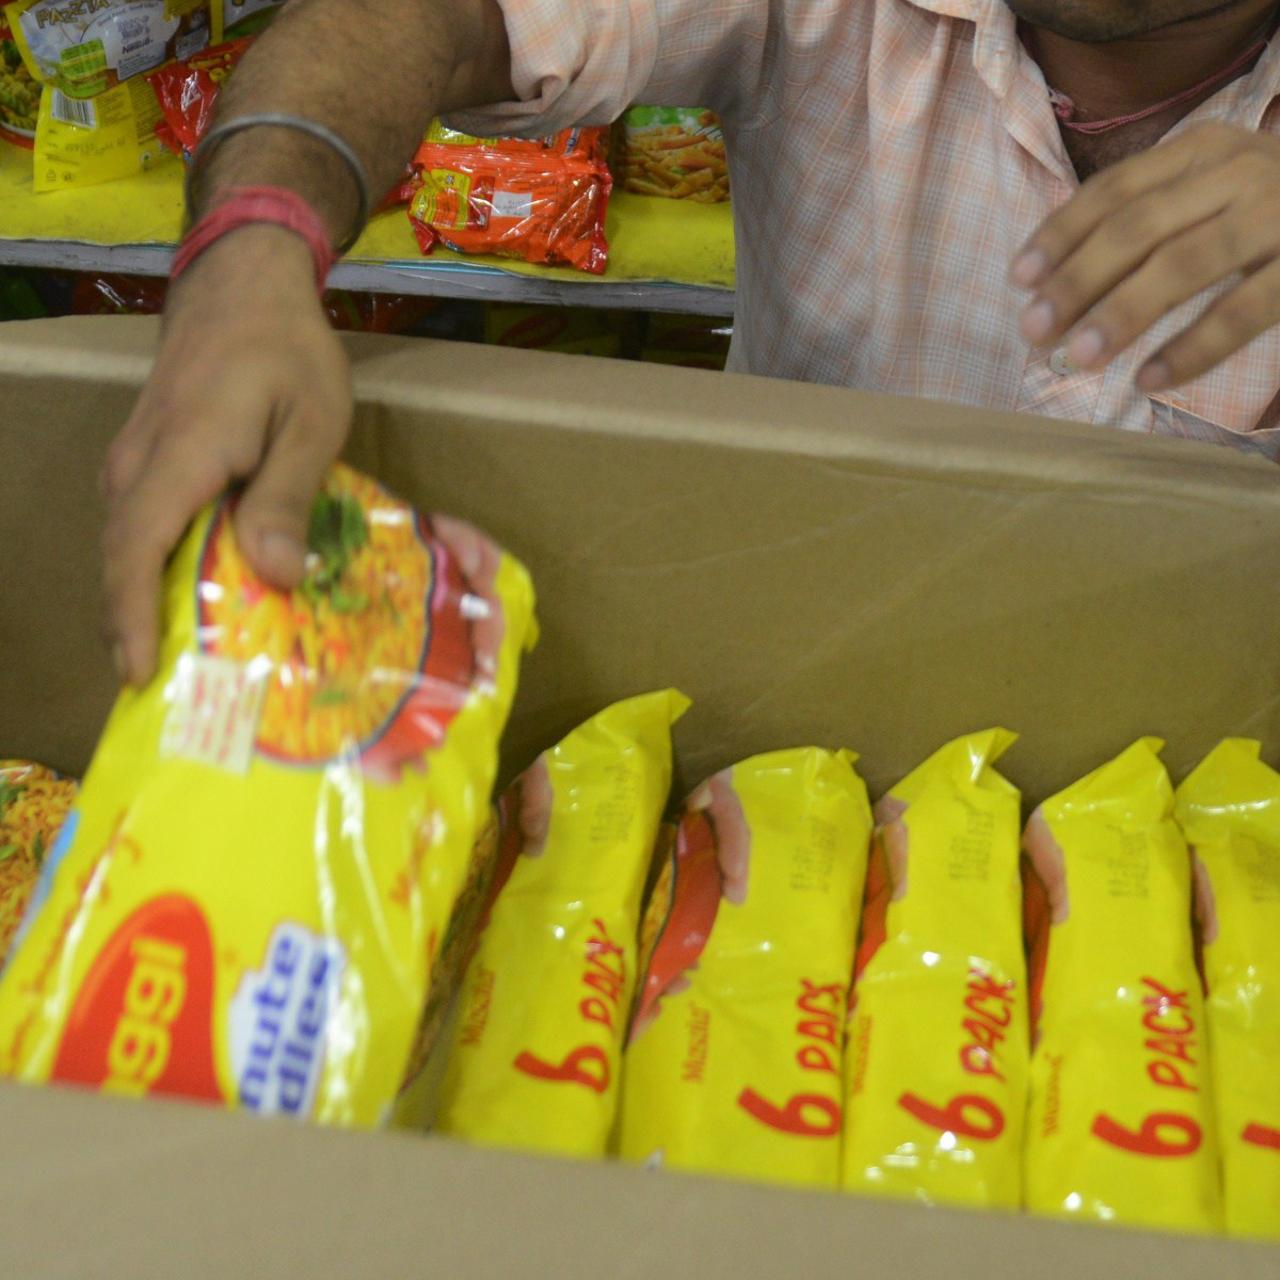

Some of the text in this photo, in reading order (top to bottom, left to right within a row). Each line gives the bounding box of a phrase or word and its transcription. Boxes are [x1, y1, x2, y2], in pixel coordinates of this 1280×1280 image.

[512, 918, 625, 1094] 6 PACK
[736, 976, 843, 1140] 6 PACK
[897, 966, 1016, 1142] 6 PACK
[1091, 976, 1203, 1159] 6 PACK
